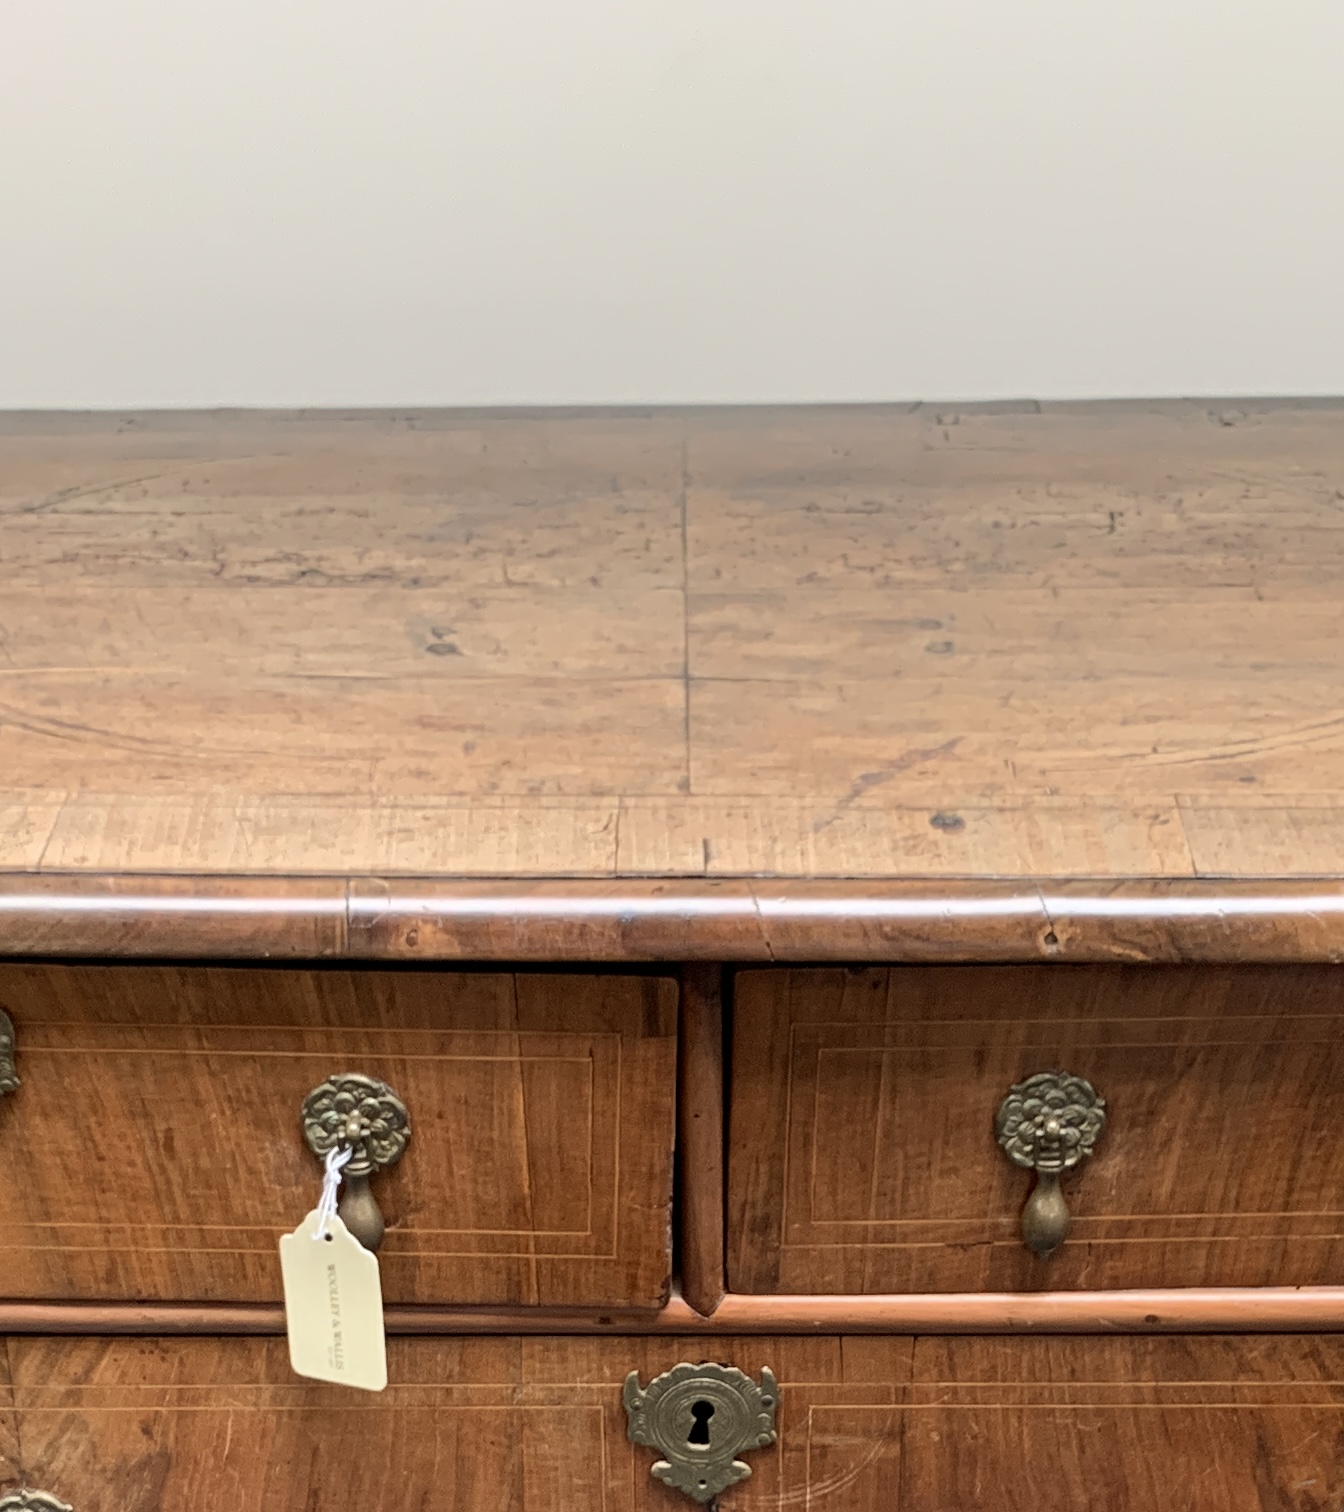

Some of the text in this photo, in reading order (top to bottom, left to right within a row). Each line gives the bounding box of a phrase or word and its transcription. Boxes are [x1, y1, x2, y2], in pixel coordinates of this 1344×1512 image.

[327, 1263, 344, 1370] WOOLLEY & WALLIS
